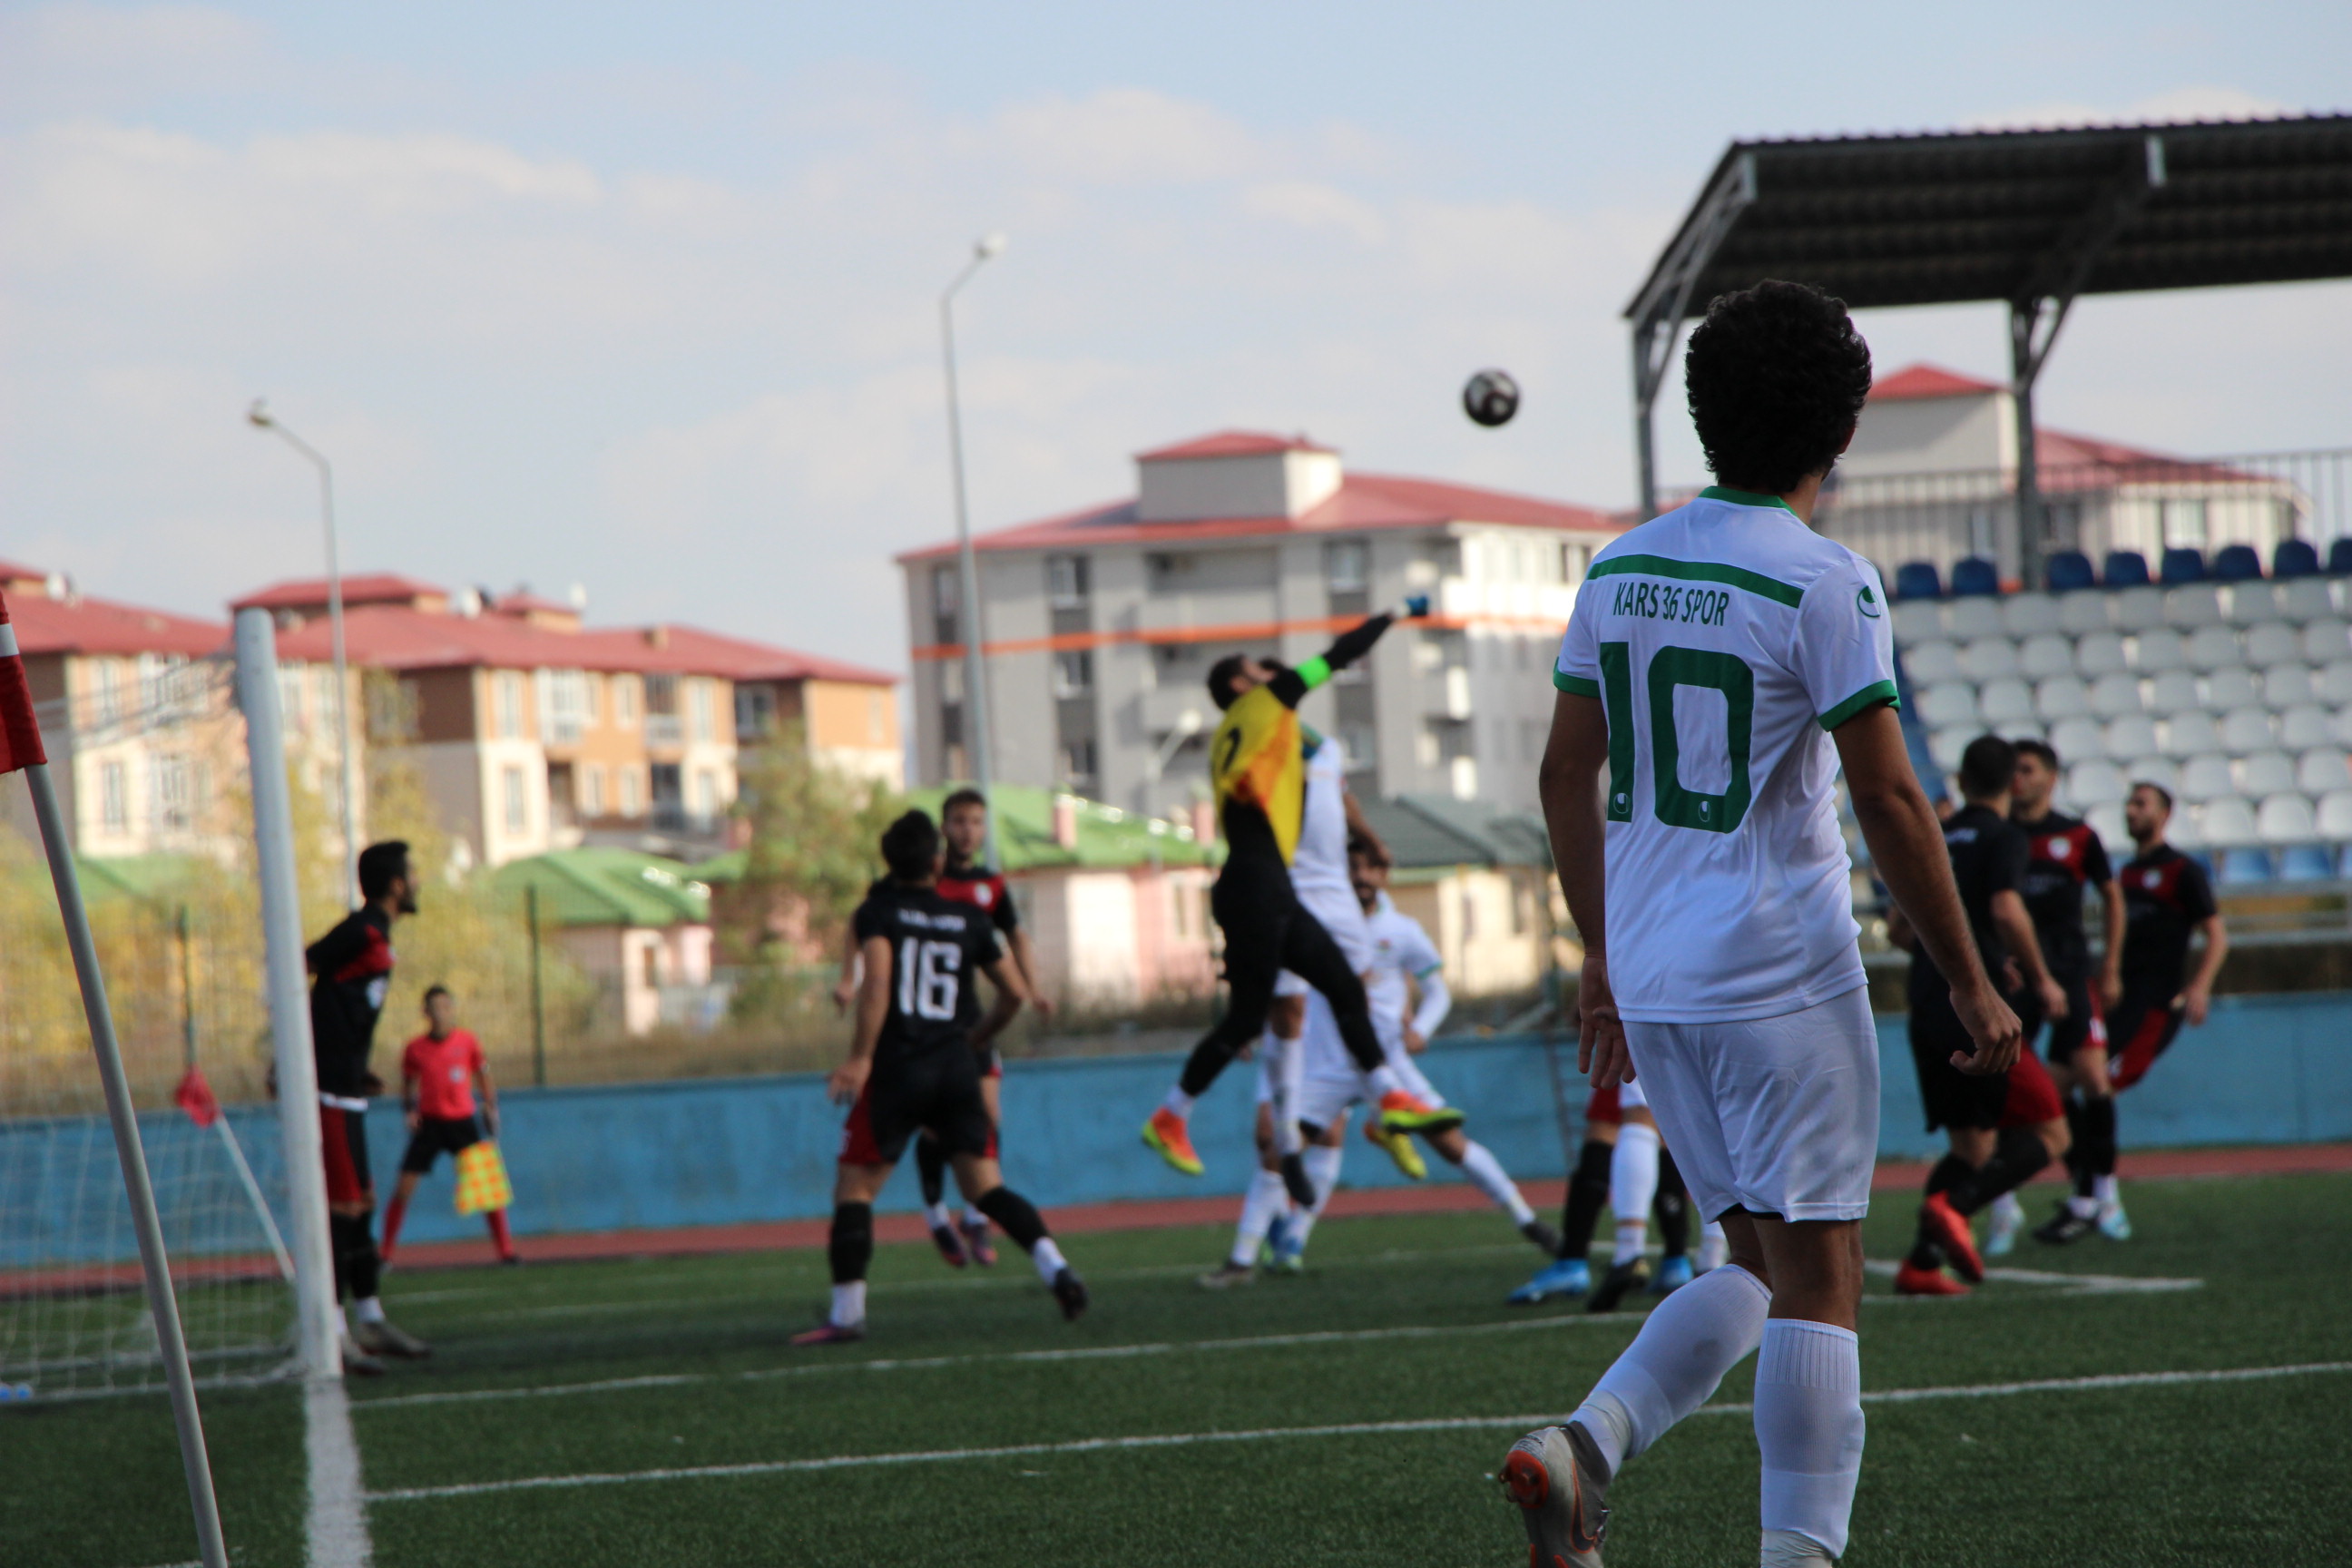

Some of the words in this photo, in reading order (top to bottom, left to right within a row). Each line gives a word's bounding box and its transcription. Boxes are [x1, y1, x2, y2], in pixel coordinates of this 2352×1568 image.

[1613, 583, 1660, 618] KARS
[1662, 585, 1682, 621] 36
[1681, 589, 1730, 626] SPOR
[1600, 642, 1754, 834] 10
[898, 936, 962, 1021] 16
